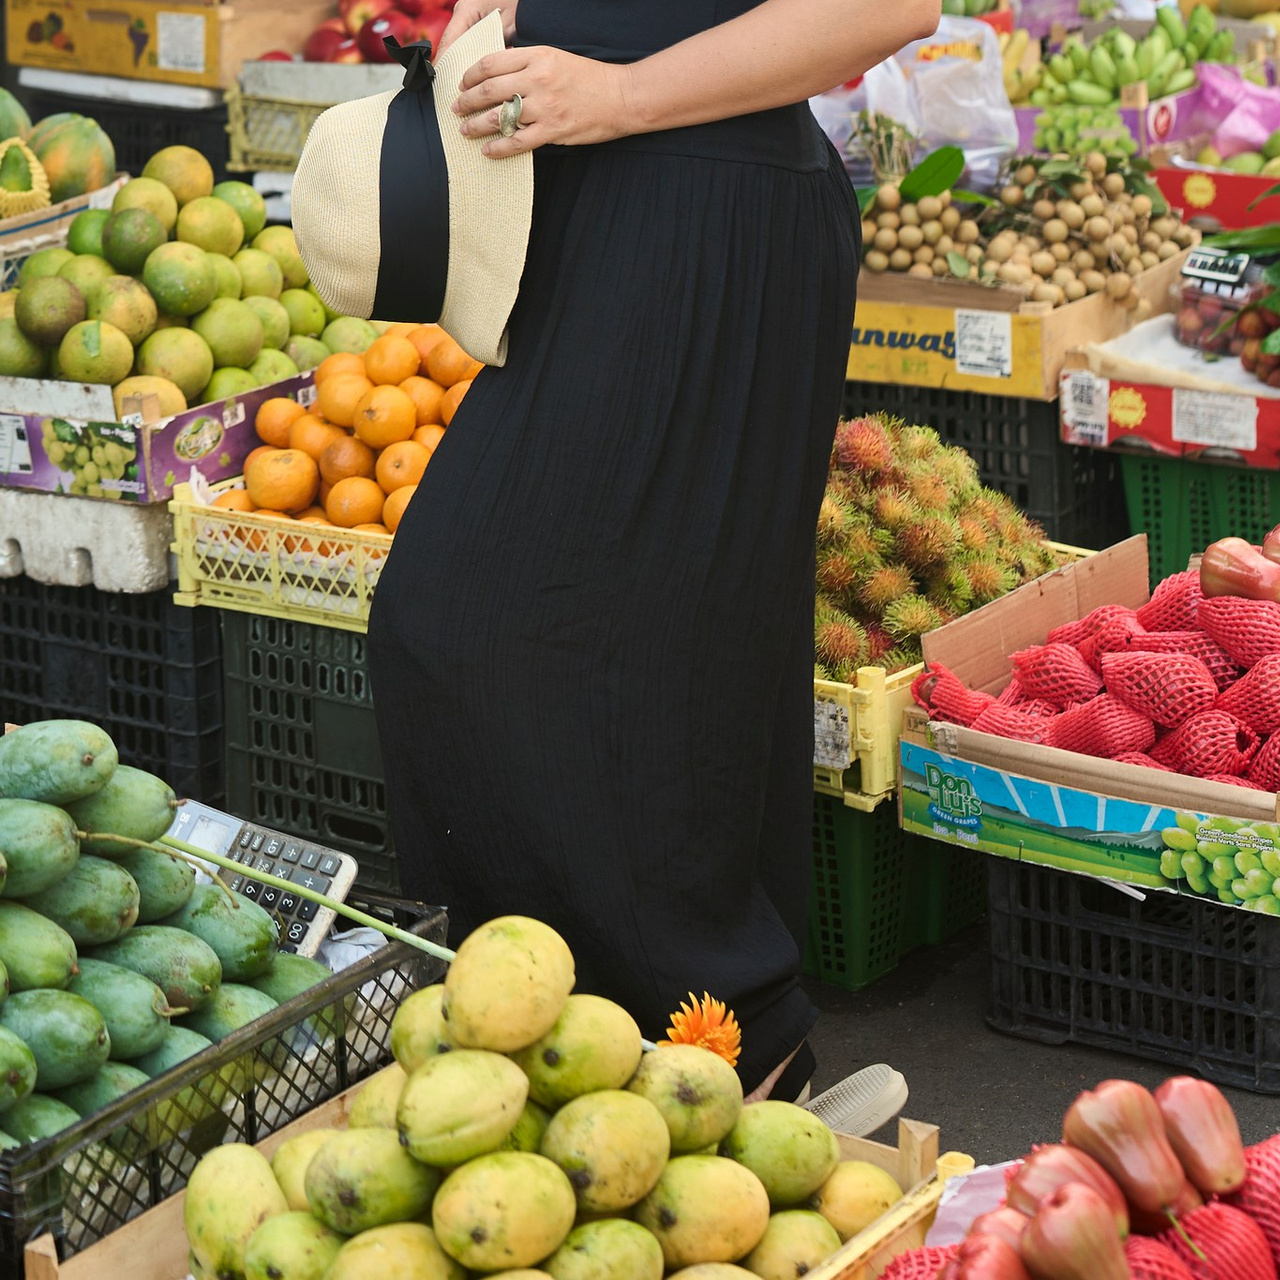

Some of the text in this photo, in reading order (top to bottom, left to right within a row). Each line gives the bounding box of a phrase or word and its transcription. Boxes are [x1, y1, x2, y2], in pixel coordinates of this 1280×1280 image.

[924, 761, 972, 798] Don
[938, 786, 983, 819] Luis
[932, 805, 979, 826] GREEN GRAPES
[933, 822, 948, 836] Ica
[267, 838, 279, 853] GT
[246, 885, 256, 895] 9
[264, 892, 275, 901] 6
[282, 898, 293, 908] 3
[288, 922, 303, 939] 00
